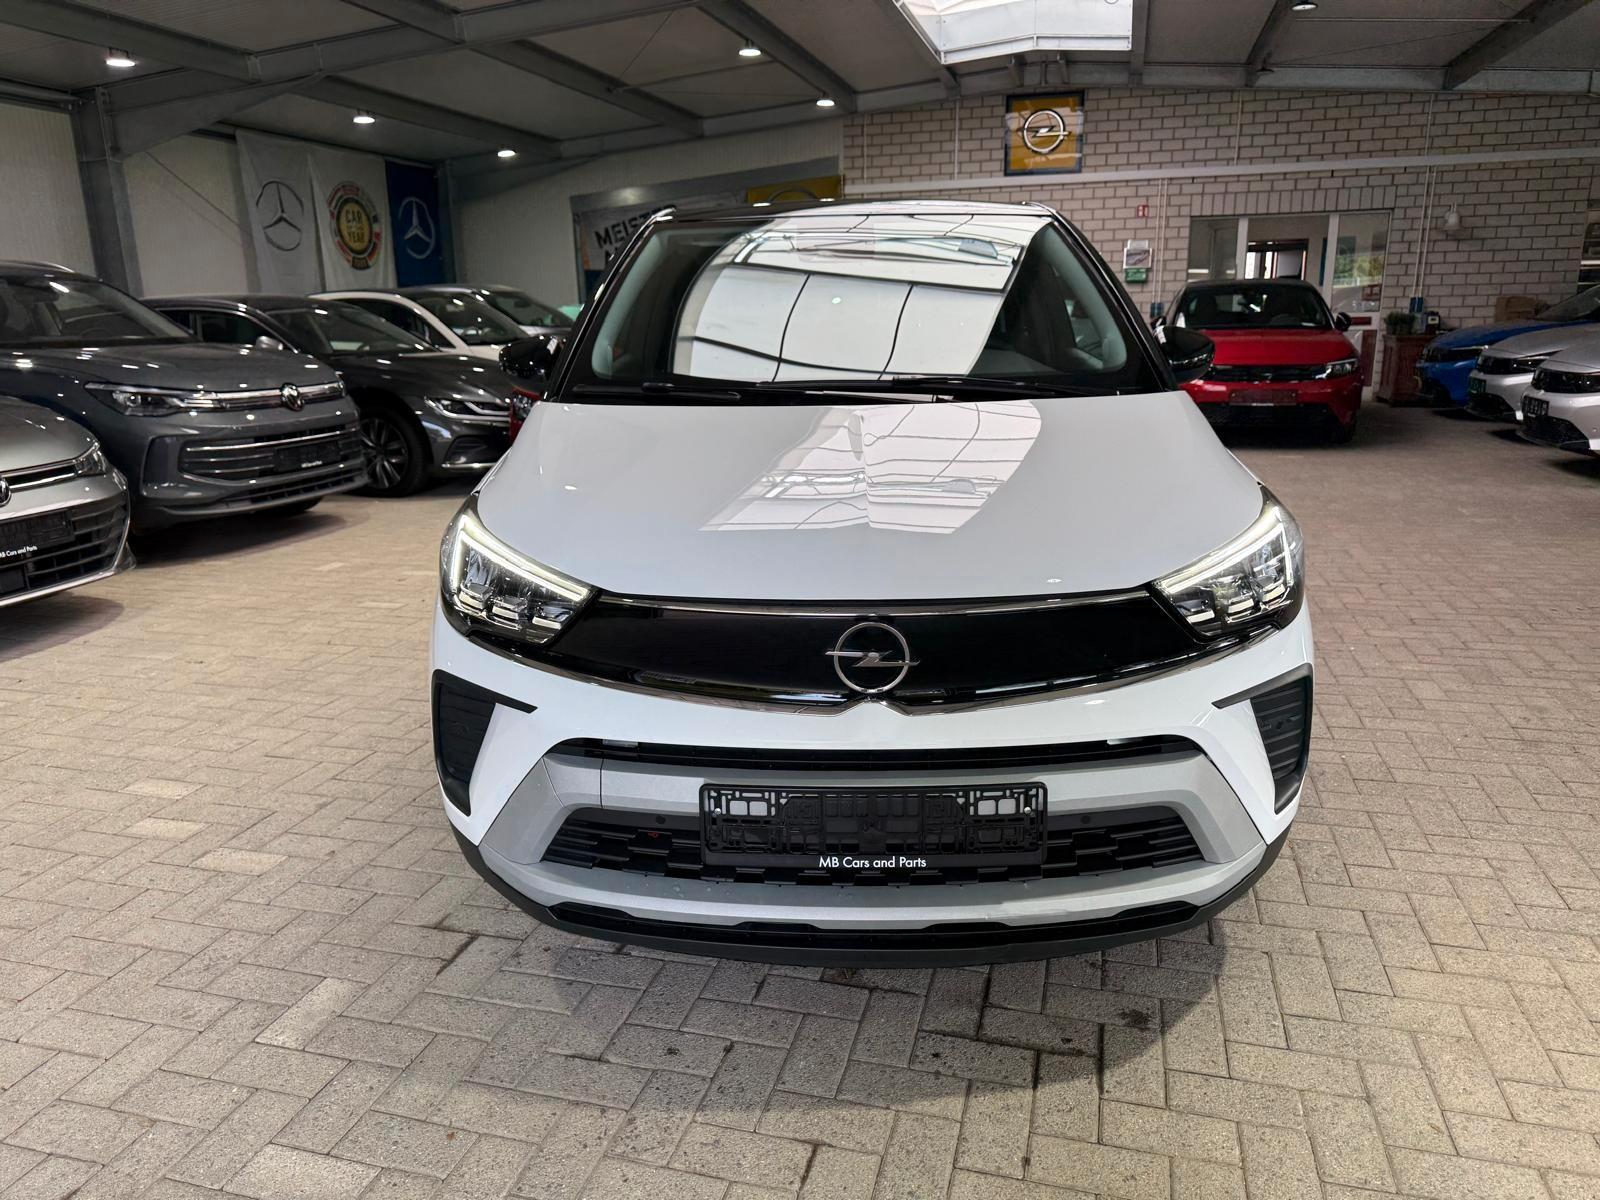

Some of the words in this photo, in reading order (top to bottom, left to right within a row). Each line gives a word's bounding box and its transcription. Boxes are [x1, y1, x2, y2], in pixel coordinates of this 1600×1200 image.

[345, 209, 363, 224] CAR
[347, 231, 366, 243] YEAR
[818, 856, 840, 868] MB
[842, 856, 870, 868] Cars
[872, 855, 896, 868] and
[899, 856, 927, 868] Parts
